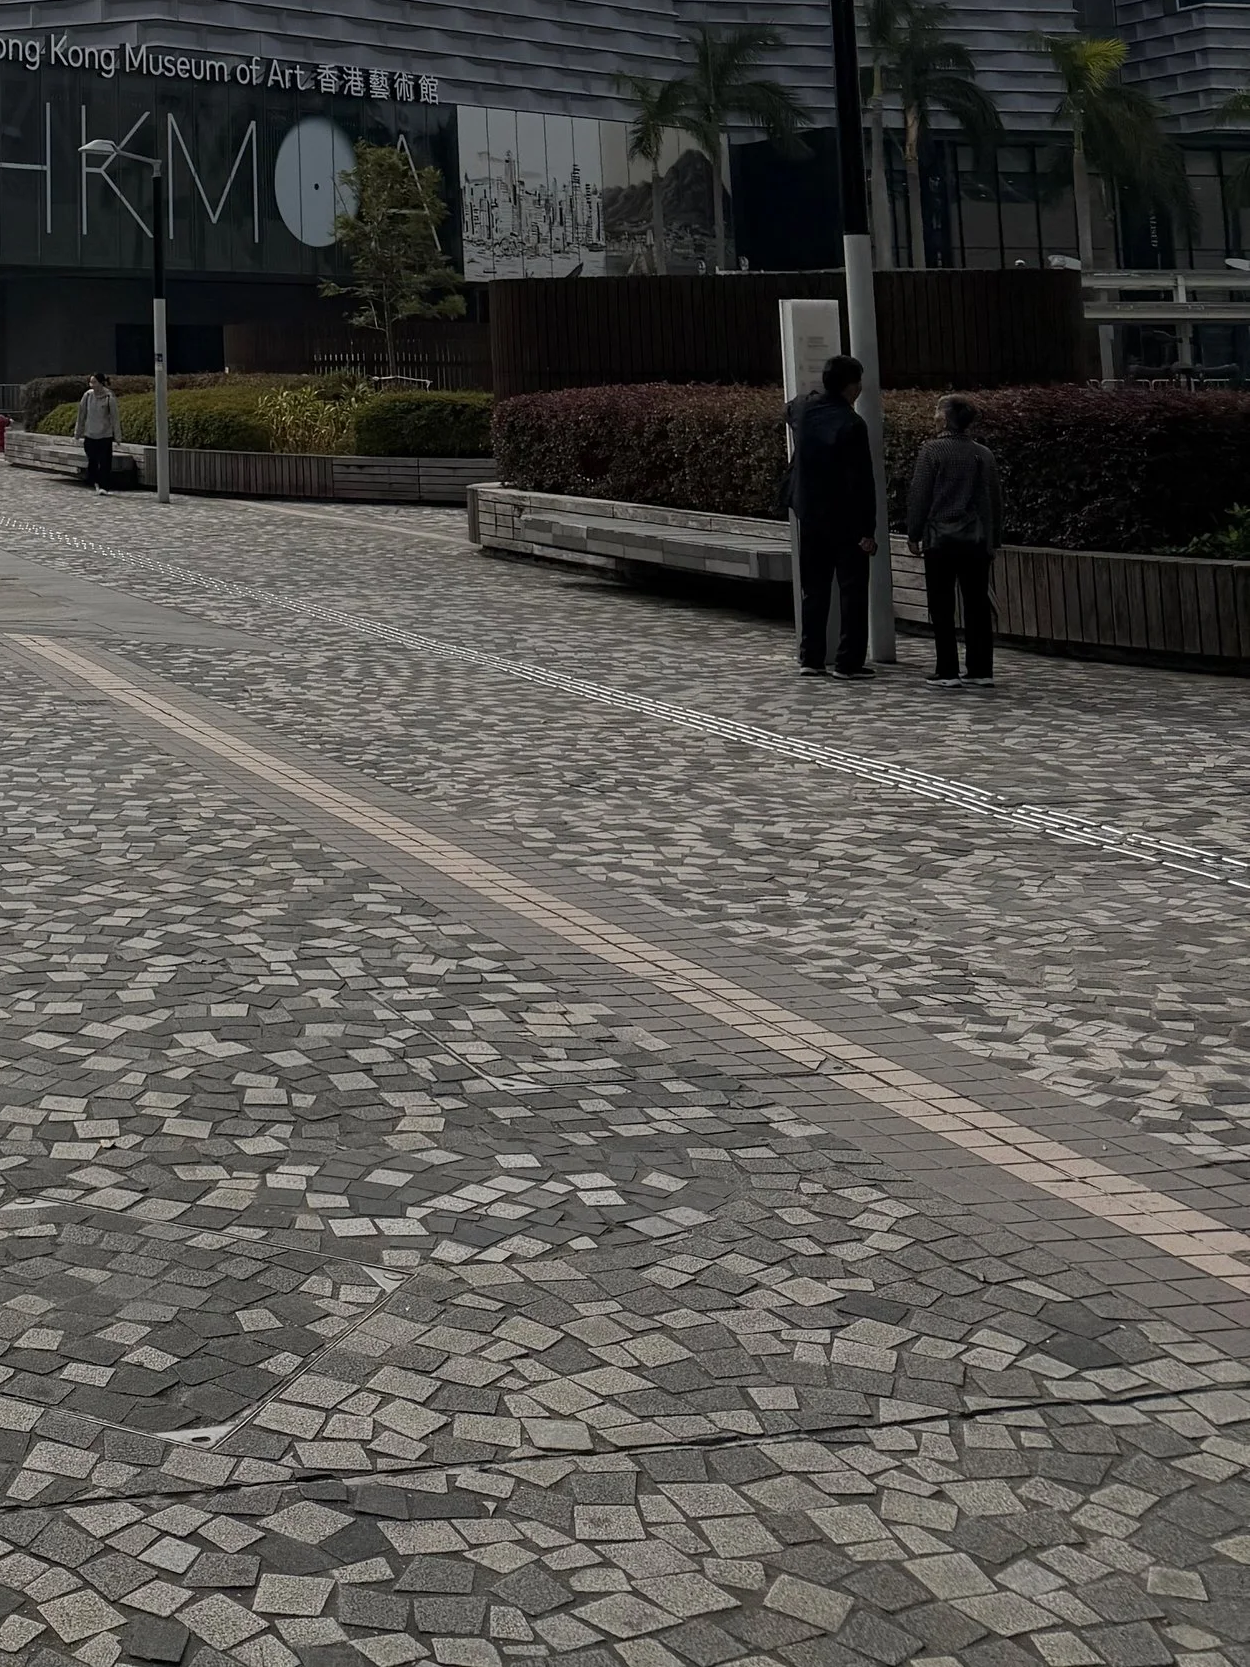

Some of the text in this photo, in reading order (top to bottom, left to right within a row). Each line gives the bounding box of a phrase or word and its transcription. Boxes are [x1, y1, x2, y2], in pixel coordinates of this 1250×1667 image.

[50, 34, 116, 78] Kong
[125, 43, 229, 83] Museum
[236, 56, 261, 86] of
[268, 58, 306, 90] Art
[316, 64, 441, 106] 香港藝術館
